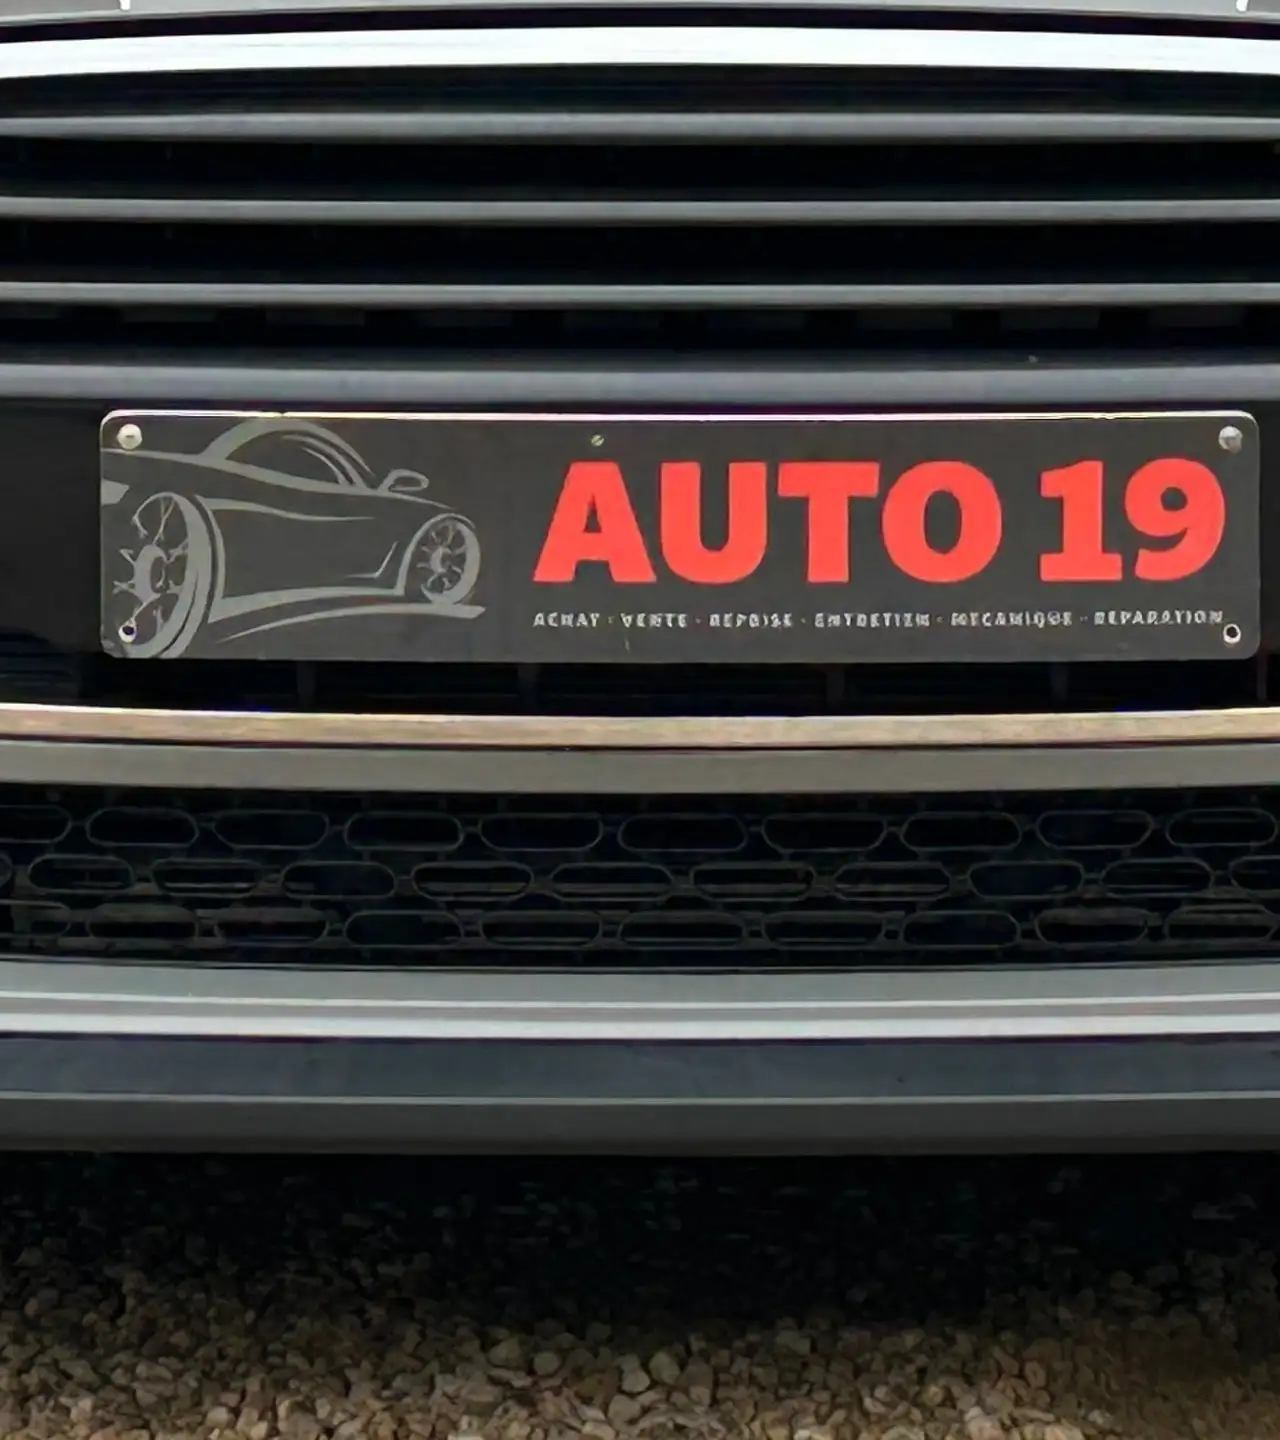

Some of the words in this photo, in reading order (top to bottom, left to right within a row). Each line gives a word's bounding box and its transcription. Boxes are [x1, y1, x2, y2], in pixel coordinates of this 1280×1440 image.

[533, 459, 1003, 584] AUTO
[1038, 457, 1226, 582] 19
[532, 612, 601, 628] ACHAT
[620, 612, 688, 628] VENTE
[709, 612, 793, 628] REPRISE
[814, 611, 930, 628] ENTRETIEN
